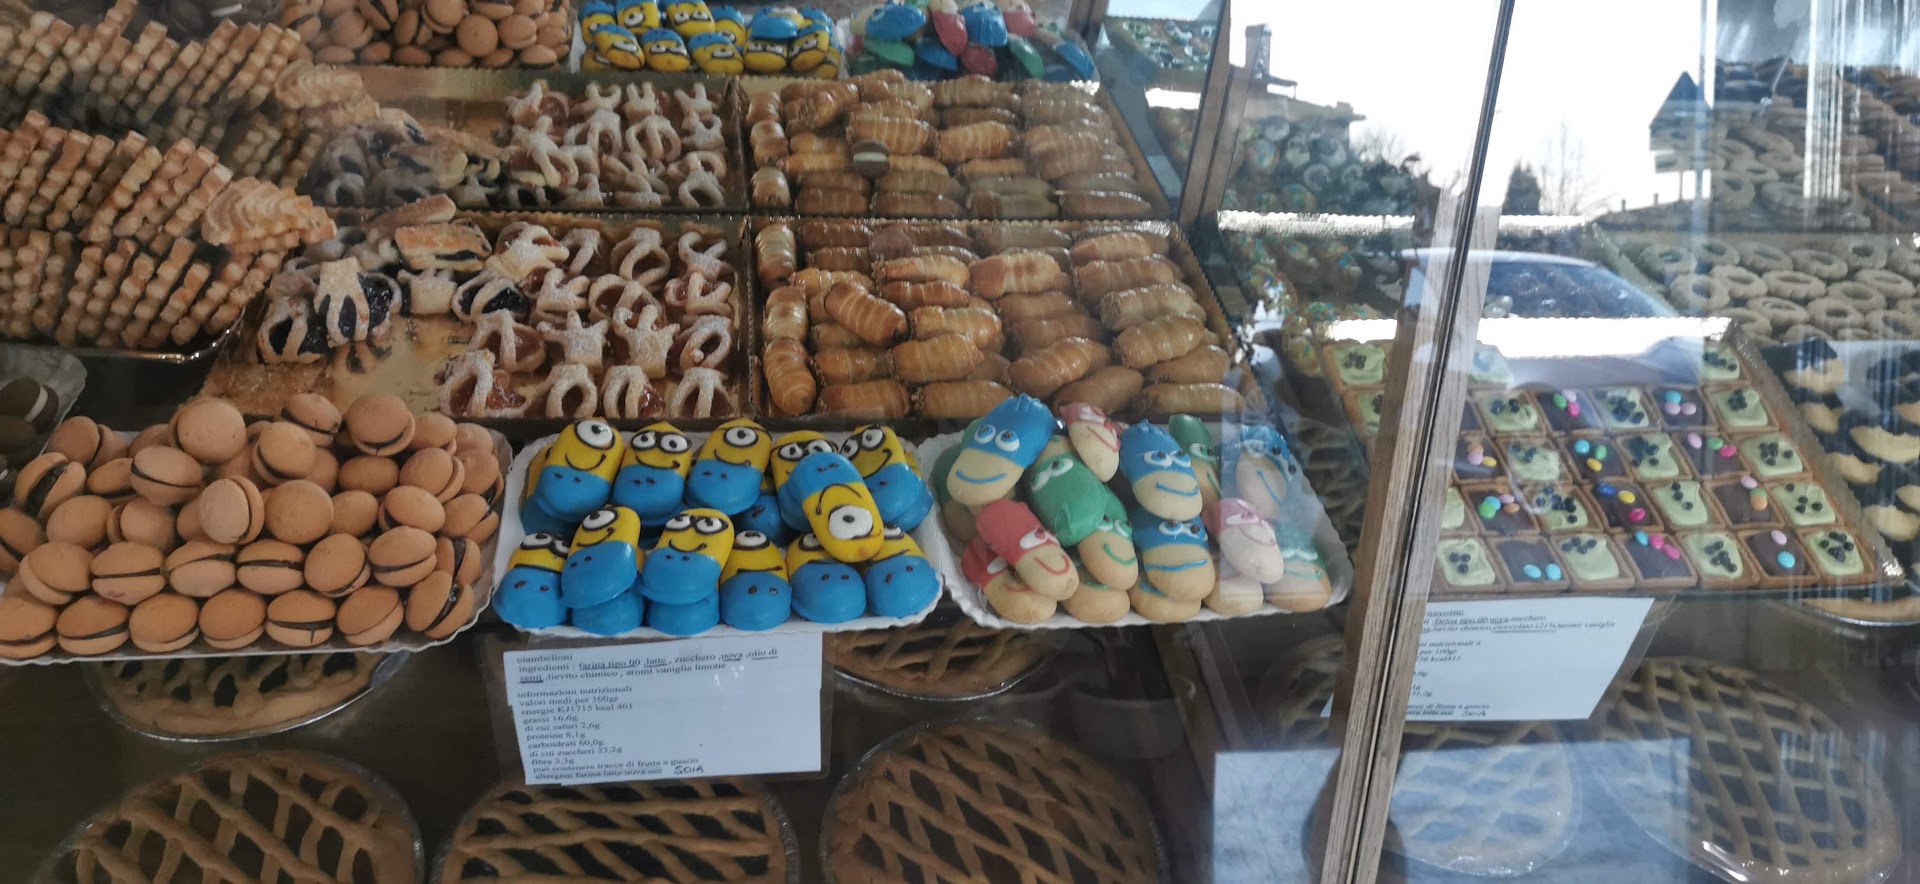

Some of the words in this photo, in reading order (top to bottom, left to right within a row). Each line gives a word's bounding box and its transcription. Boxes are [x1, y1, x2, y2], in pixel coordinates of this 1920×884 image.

[517, 654, 573, 663] ciambelloni
[518, 664, 570, 673] ingredienti
[579, 662, 606, 670] farina
[608, 660, 627, 669] tipo
[674, 654, 716, 662] zucchero
[580, 670, 618, 679] chimico
[656, 664, 692, 674] vaniglia
[695, 662, 726, 671] limone
[518, 687, 577, 698] informazioni
[580, 685, 632, 695] nutrizionali
[519, 698, 546, 707] valori
[549, 697, 572, 705] medi
[574, 698, 589, 706] per
[593, 695, 619, 703] 100gr
[595, 703, 614, 711] kcal
[523, 716, 550, 725] grassi
[536, 724, 550, 732] cui
[552, 723, 578, 731] saturi
[580, 722, 600, 730] 2,6g
[526, 733, 563, 742] proteine
[528, 741, 576, 749] carboidrati
[557, 747, 595, 757] zuccheri
[597, 746, 623, 755] 23,2g
[531, 758, 553, 766] fibre
[670, 757, 699, 766] guscio
[674, 765, 704, 775] SOIA
